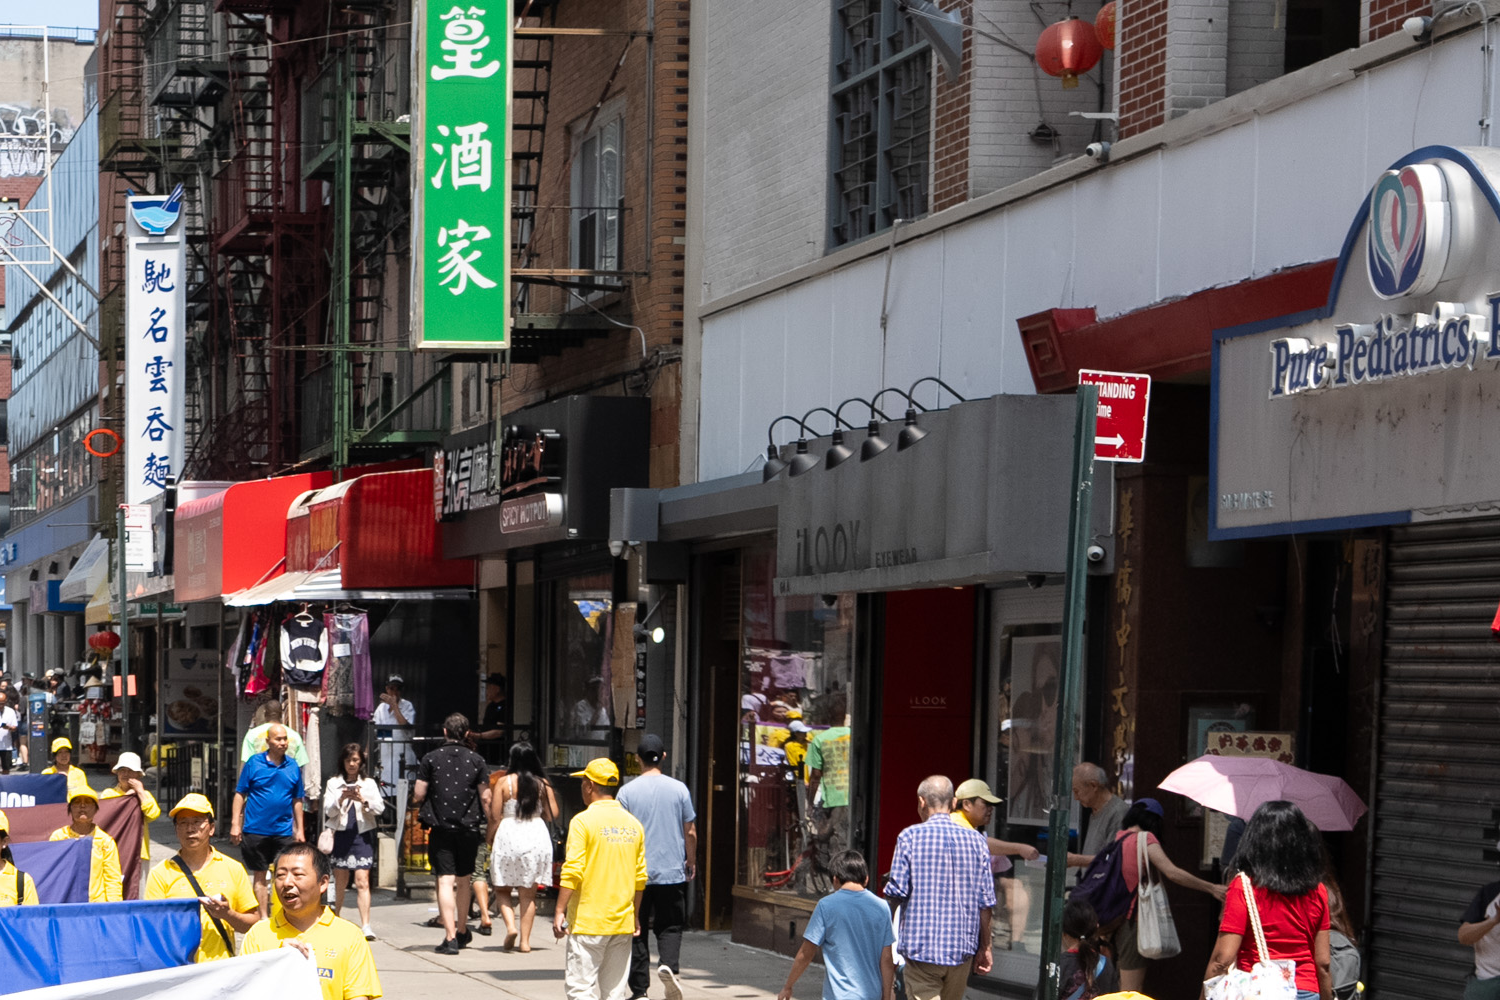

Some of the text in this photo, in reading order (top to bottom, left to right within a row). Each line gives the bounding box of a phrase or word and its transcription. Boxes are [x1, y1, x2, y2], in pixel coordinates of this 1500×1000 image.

[1272, 341, 1328, 396] Pure
[1334, 314, 1479, 385] Pediatrics,
[141, 259, 176, 489] 馳名雲吞麵
[1098, 384, 1135, 400] TANDING
[502, 505, 520, 527] SPICY
[876, 548, 918, 568] EYEWEAR
